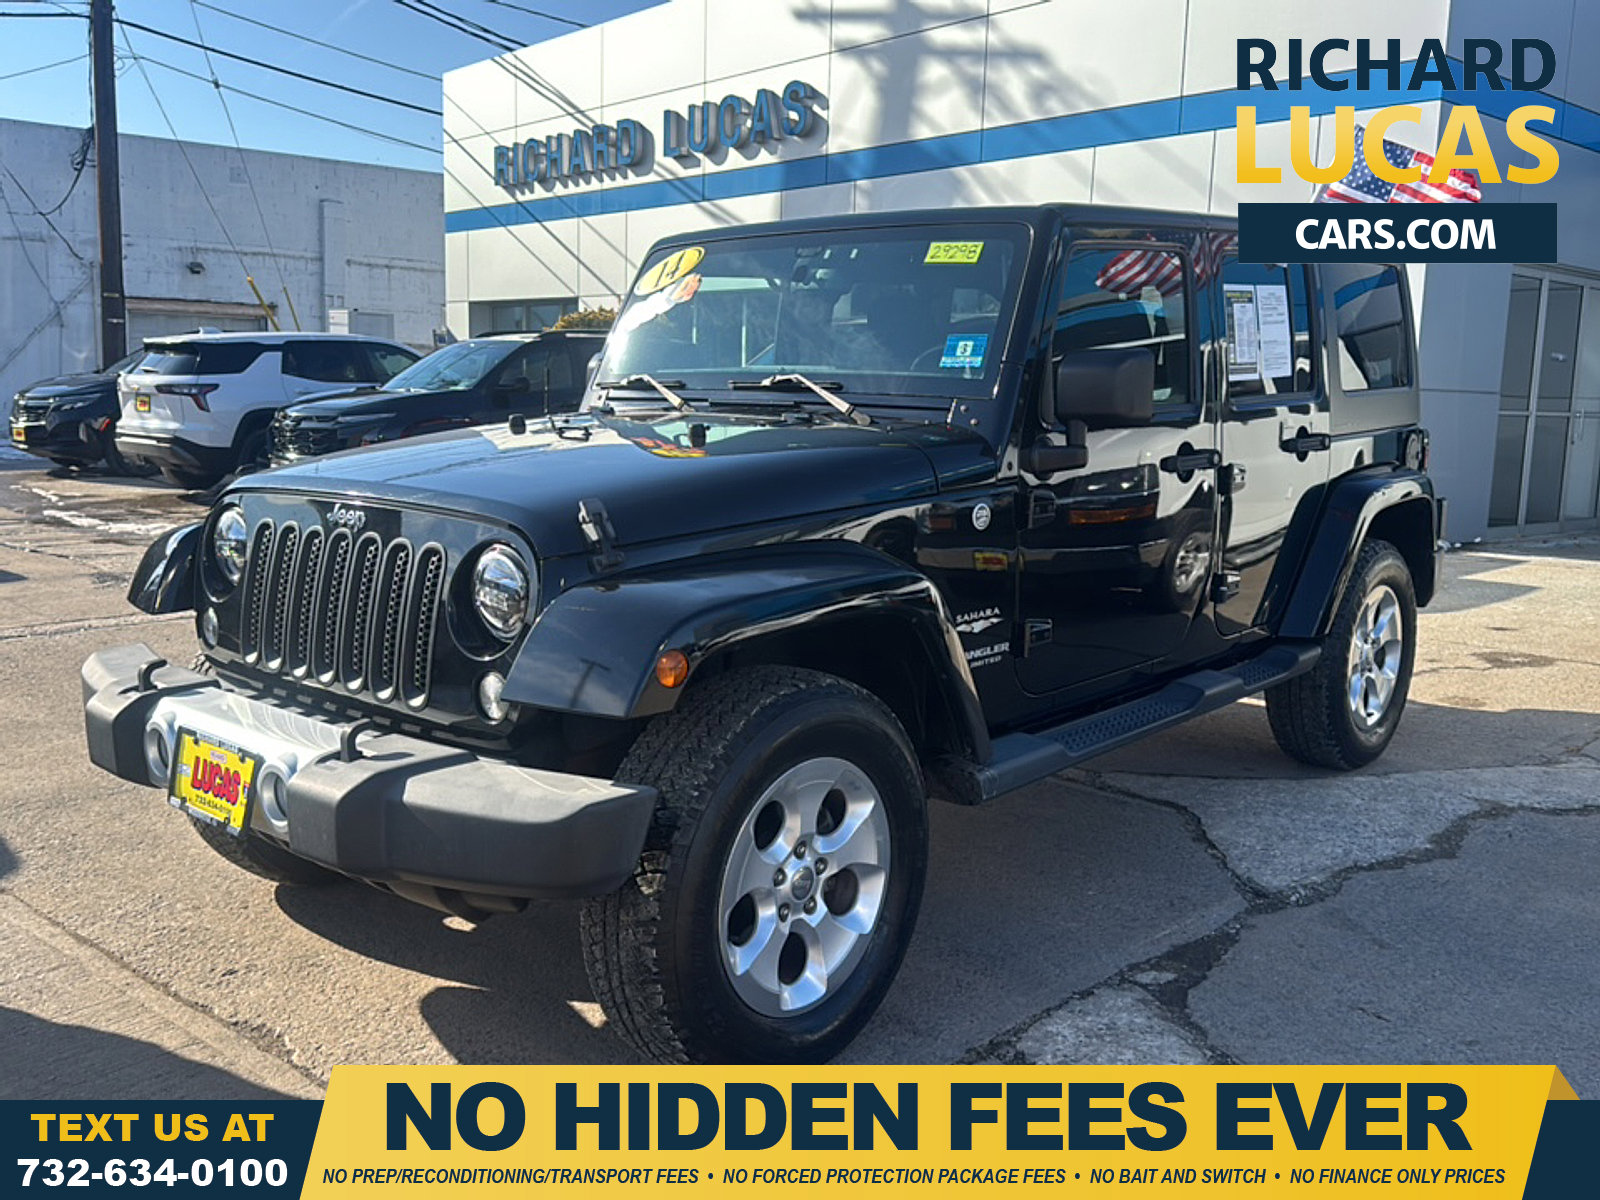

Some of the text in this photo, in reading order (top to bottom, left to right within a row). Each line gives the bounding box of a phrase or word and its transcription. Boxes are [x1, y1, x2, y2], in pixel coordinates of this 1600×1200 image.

[493, 80, 814, 186] RICHARD LUCAS
[327, 503, 366, 532] Jeep
[956, 606, 1001, 623] SAHARA
[190, 755, 241, 806] LUCAS
